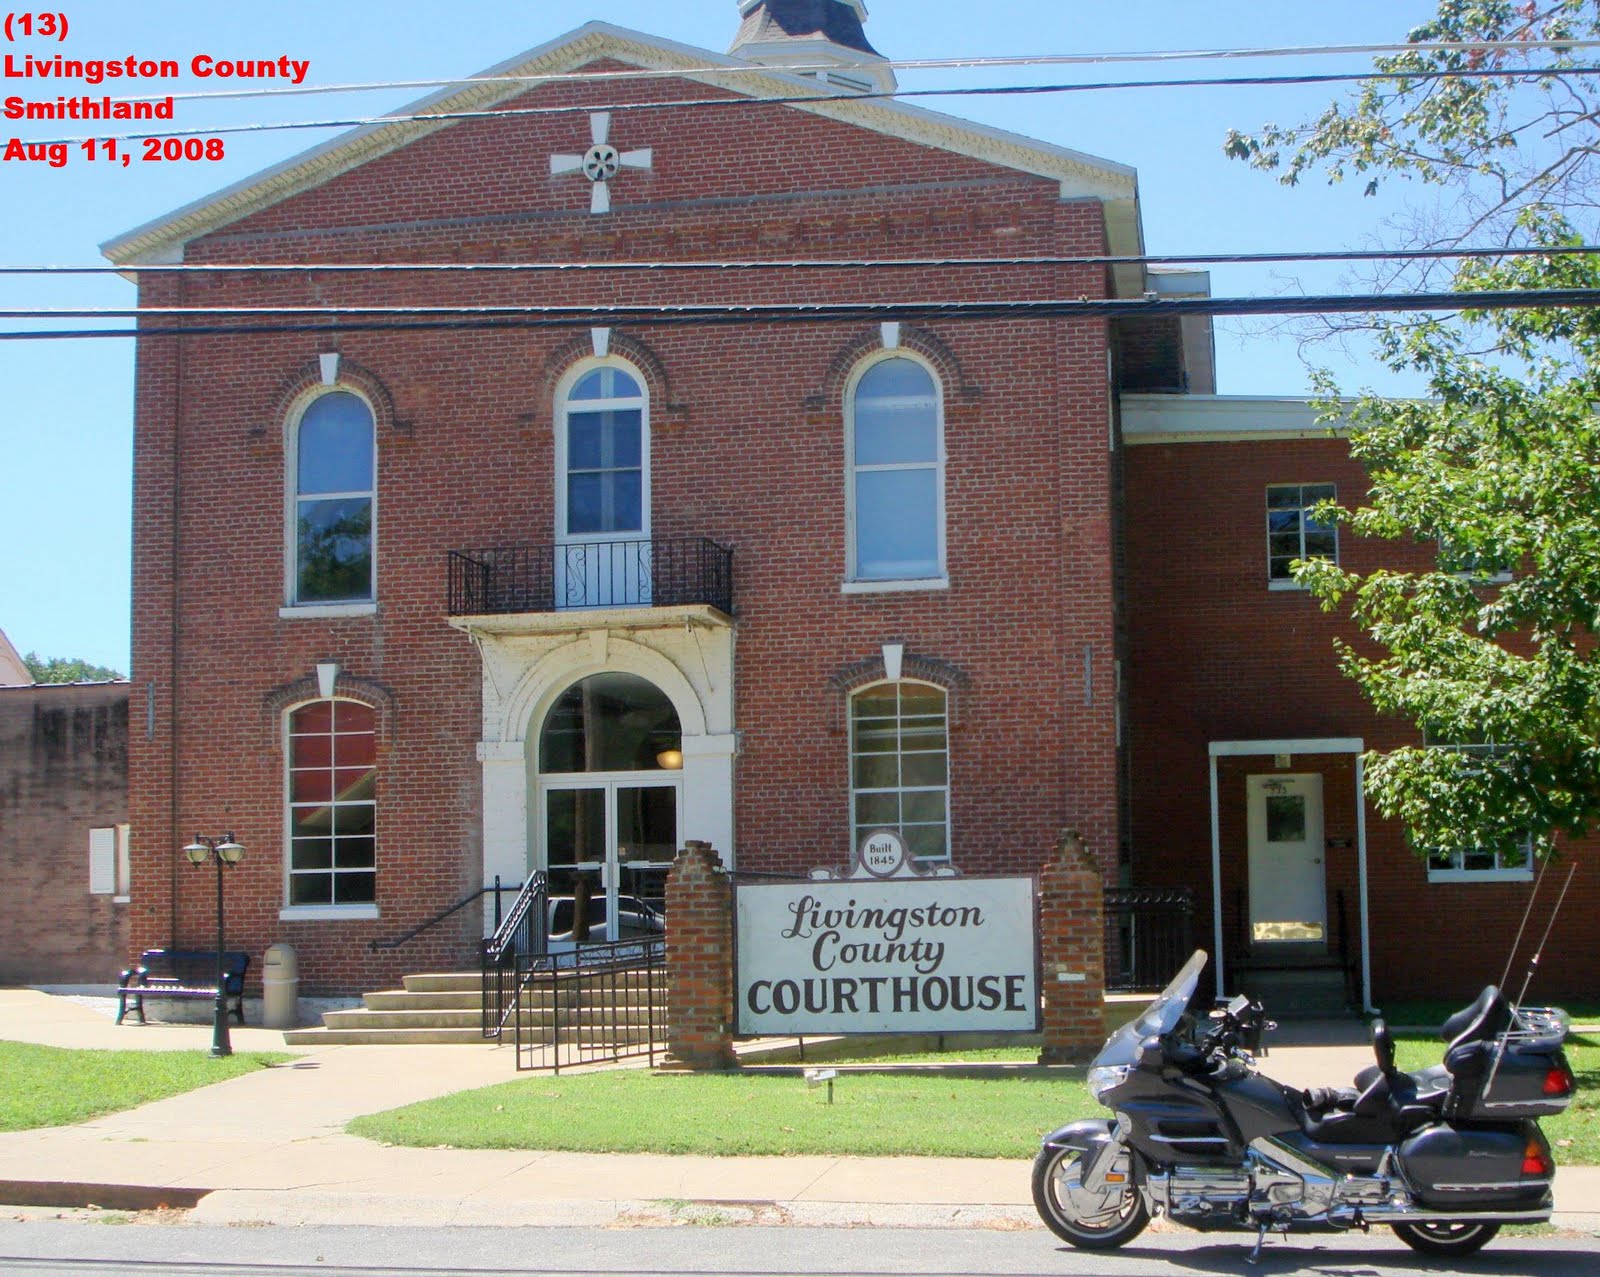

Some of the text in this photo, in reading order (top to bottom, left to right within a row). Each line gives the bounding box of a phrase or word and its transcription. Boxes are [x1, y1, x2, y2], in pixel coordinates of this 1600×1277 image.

[870, 843, 892, 853] Built
[870, 855, 895, 865] 1845
[781, 895, 984, 941] Livingston
[812, 931, 944, 974] County
[748, 975, 1027, 1015] COURTHOUSE
